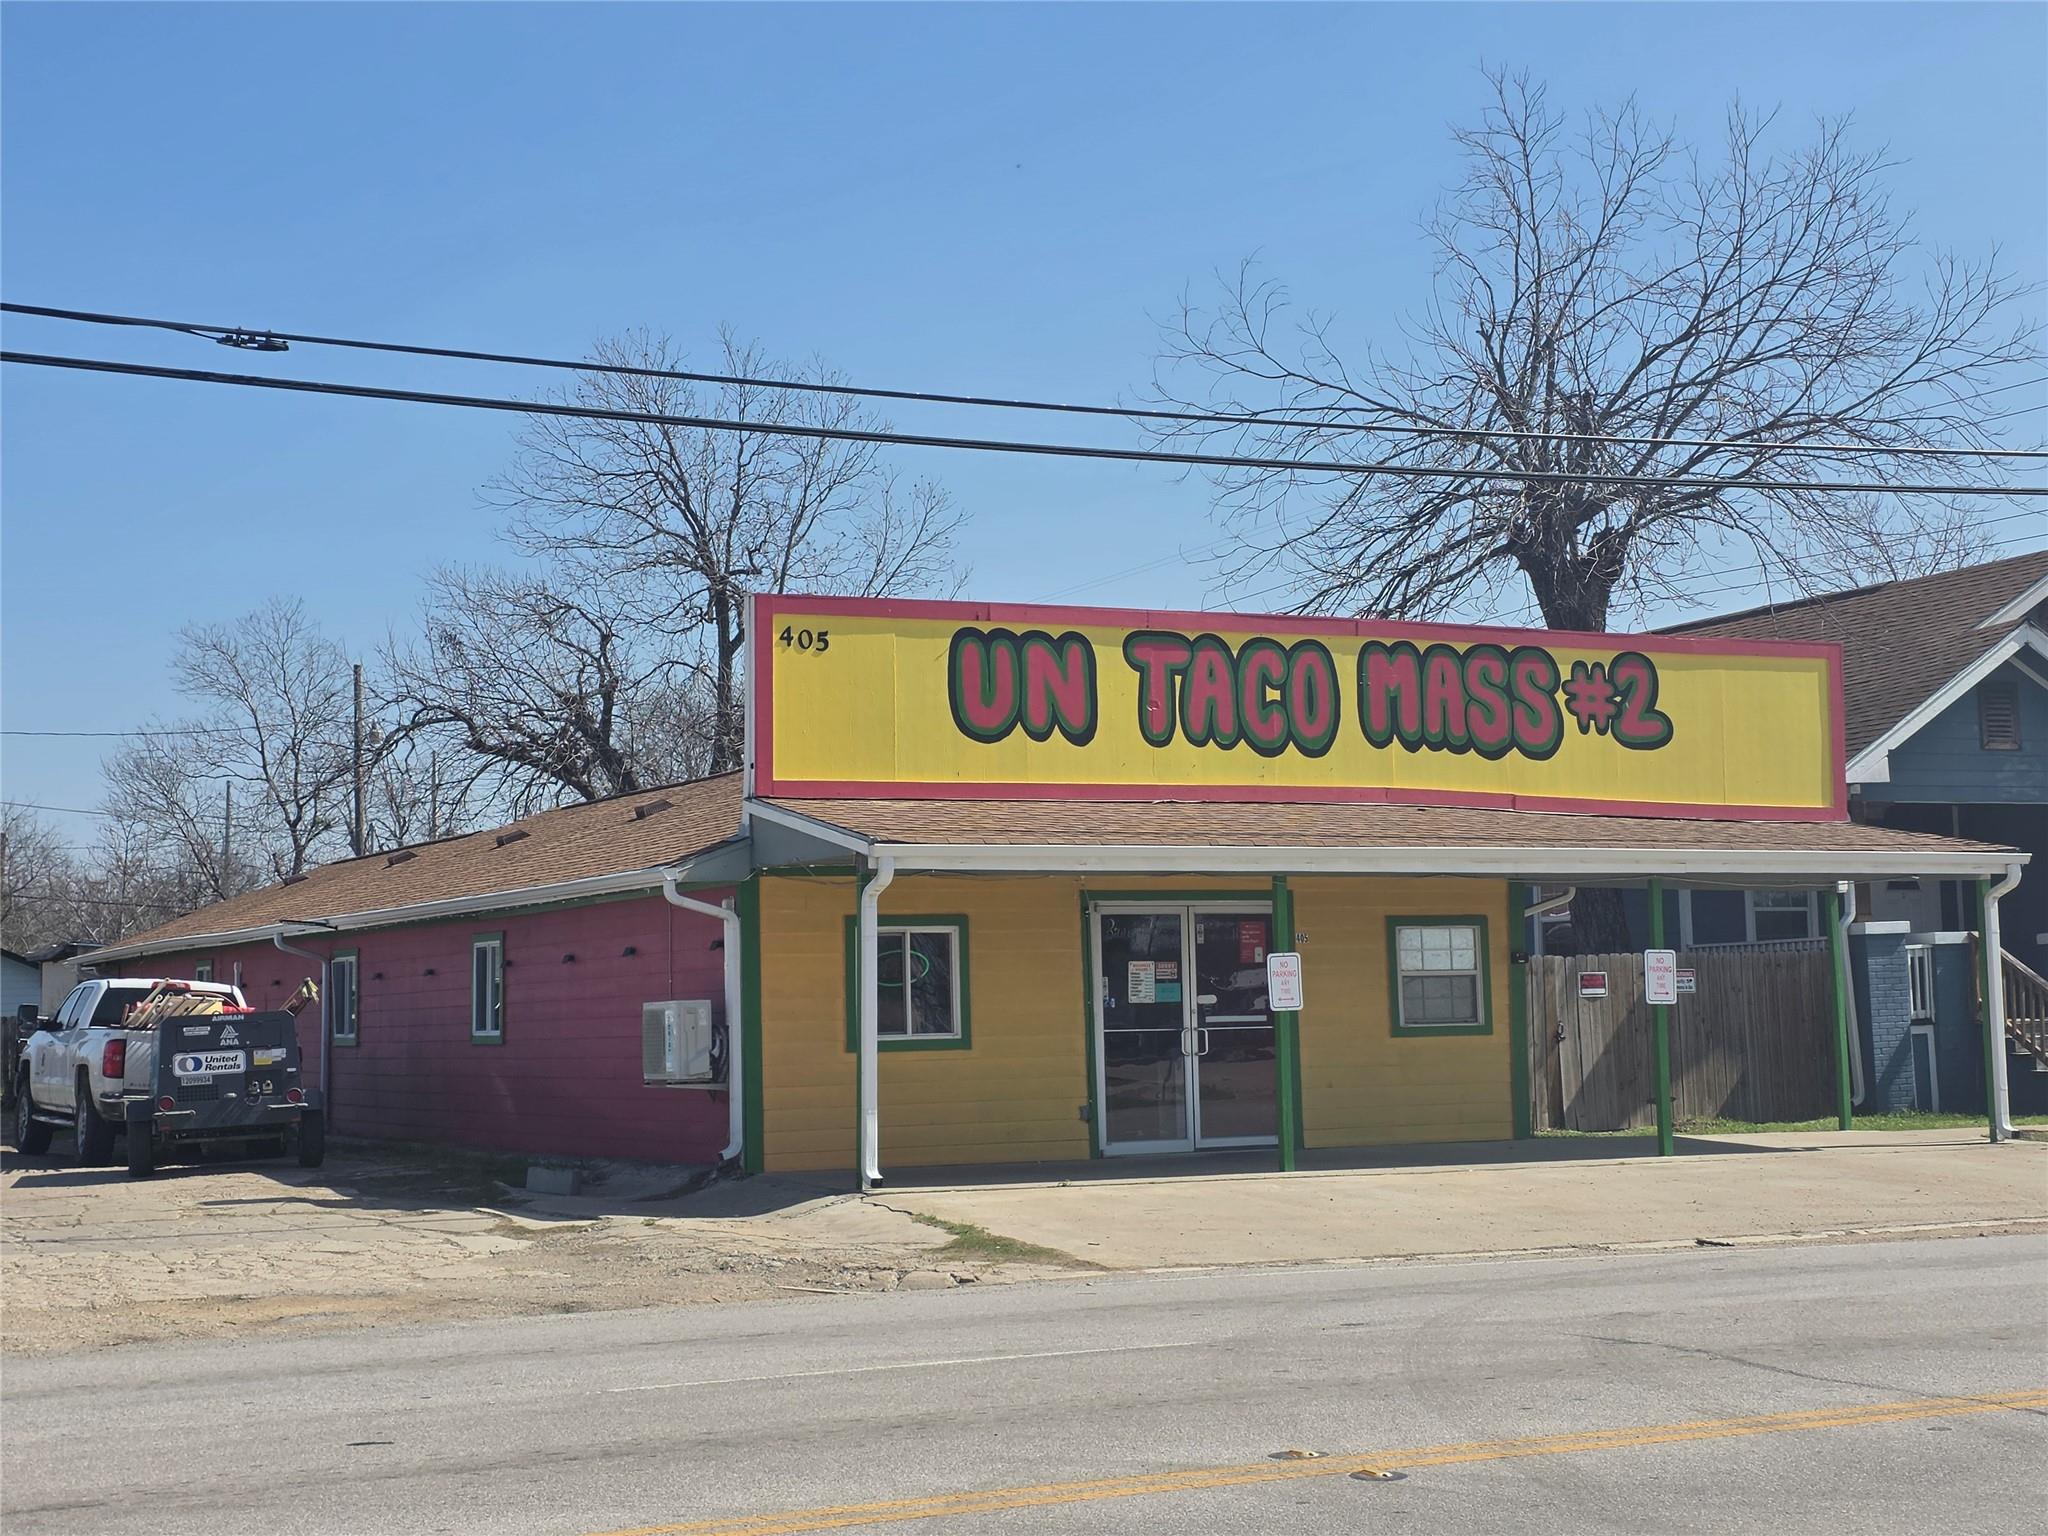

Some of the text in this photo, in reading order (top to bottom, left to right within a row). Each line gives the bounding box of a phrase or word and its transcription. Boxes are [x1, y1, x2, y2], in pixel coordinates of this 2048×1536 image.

[779, 625, 830, 652] 405
[948, 627, 1674, 760] UN TACO MASS #2
[1296, 933, 1309, 943] 405
[1656, 957, 1665, 965] NO
[1272, 969, 1297, 977] PARKING
[220, 1038, 239, 1046] ANA
[204, 1055, 238, 1063] United
[204, 1062, 241, 1072] Rentals
